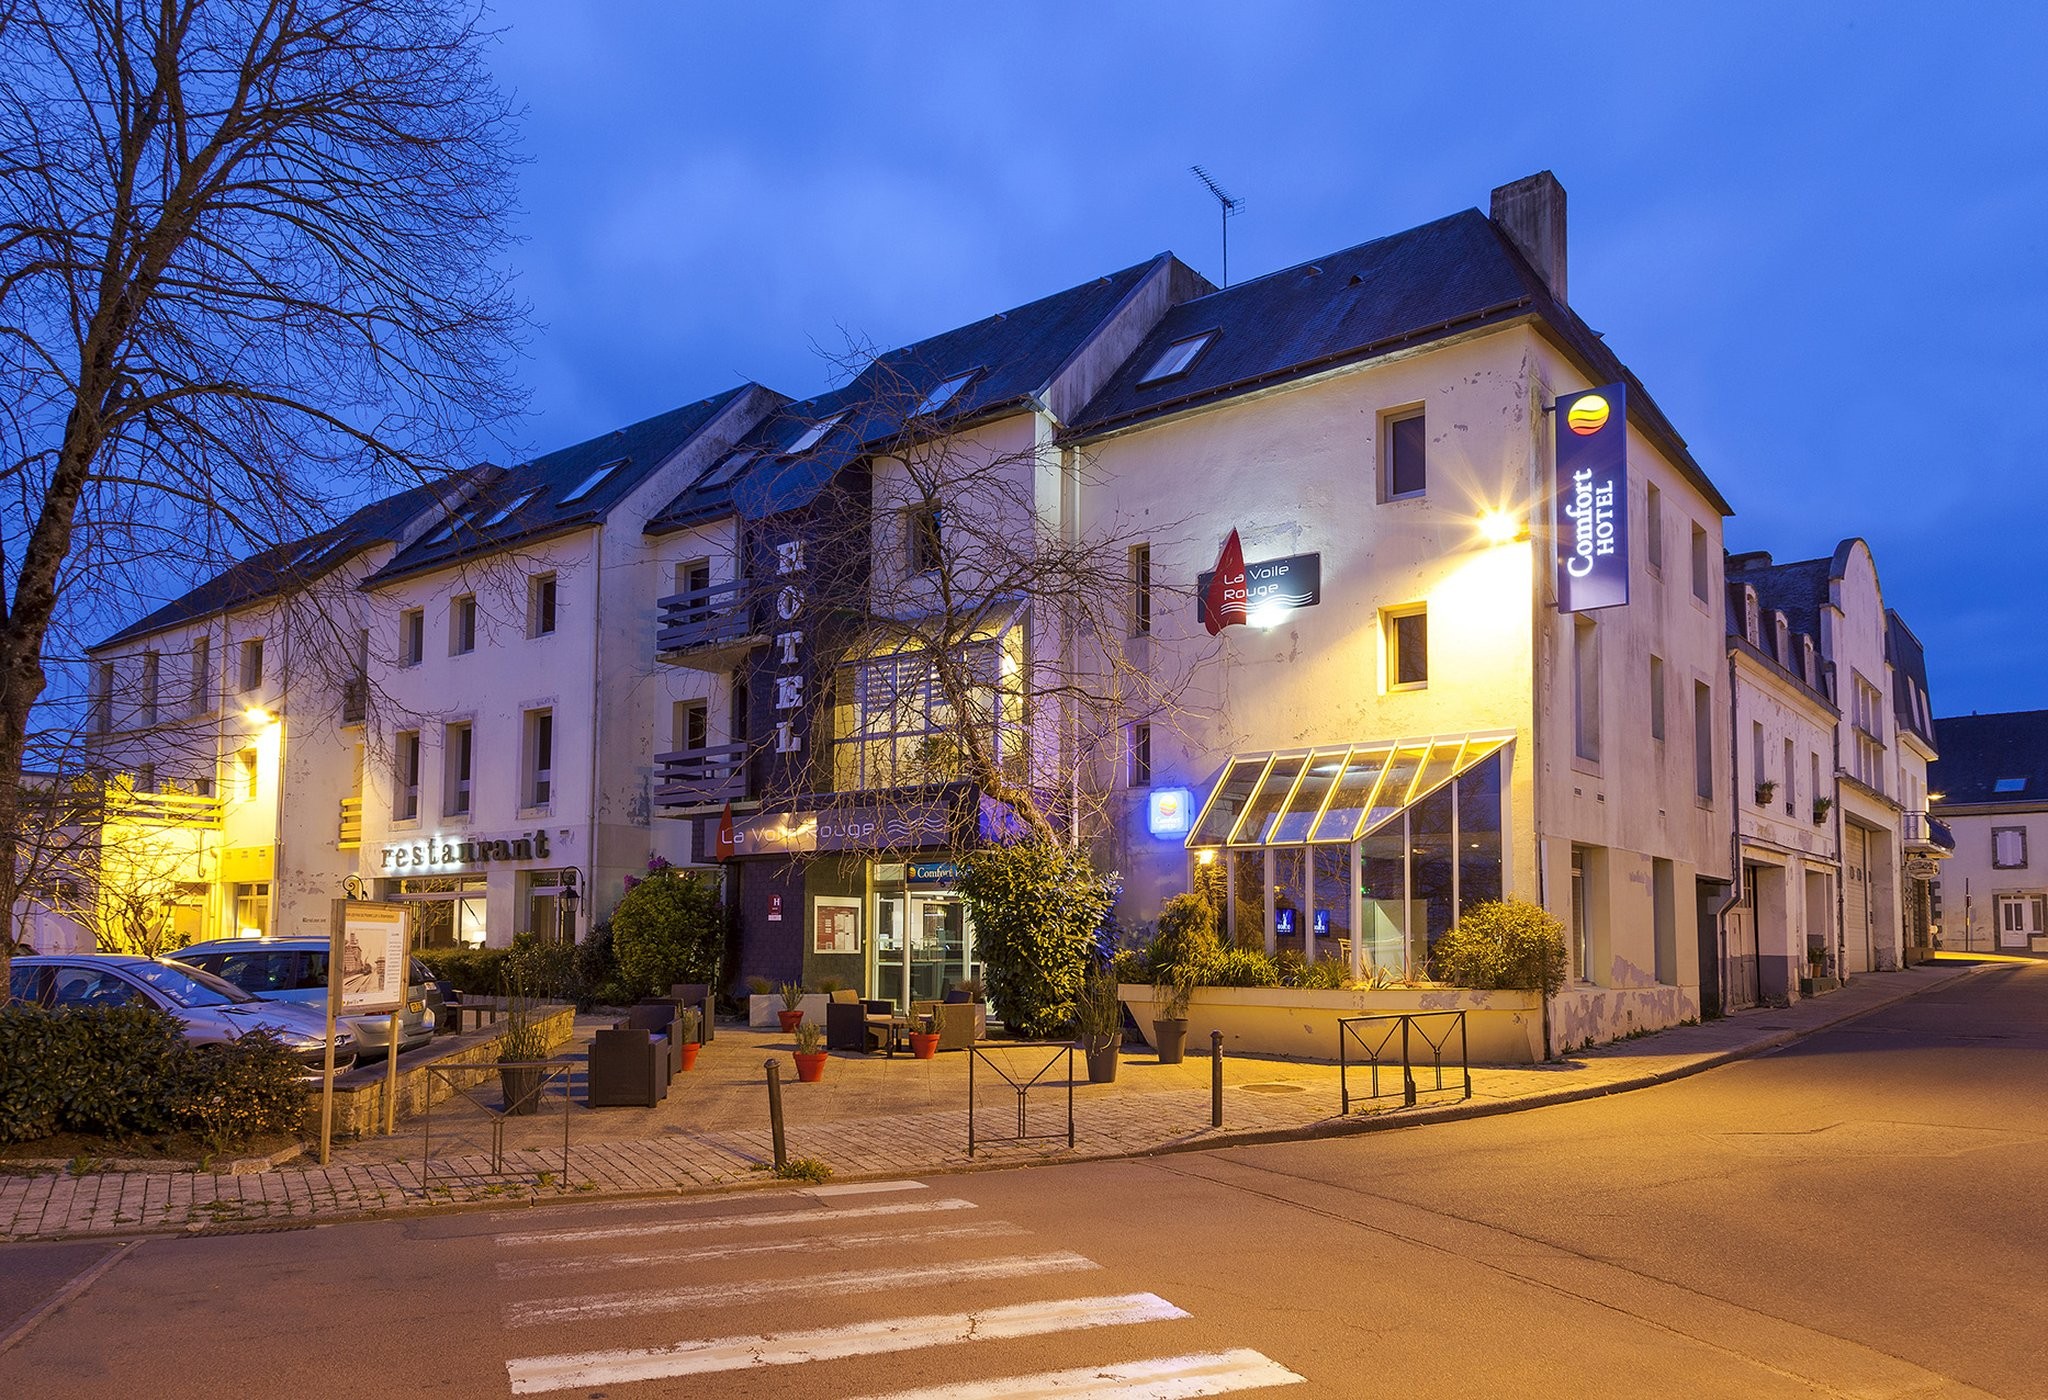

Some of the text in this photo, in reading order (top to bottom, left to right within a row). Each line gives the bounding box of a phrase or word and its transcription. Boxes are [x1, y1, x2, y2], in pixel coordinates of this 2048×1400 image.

[1565, 467, 1594, 577] Comfort
[1595, 480, 1614, 556] HOTEL
[1224, 565, 1289, 585] La Voile
[1224, 583, 1279, 601] Rouge
[776, 541, 806, 754] HOTEL
[721, 830, 745, 845] La
[751, 826, 798, 842] Voie
[381, 829, 550, 868] restaurant
[917, 866, 953, 878] Comfort
[773, 897, 780, 906] H
